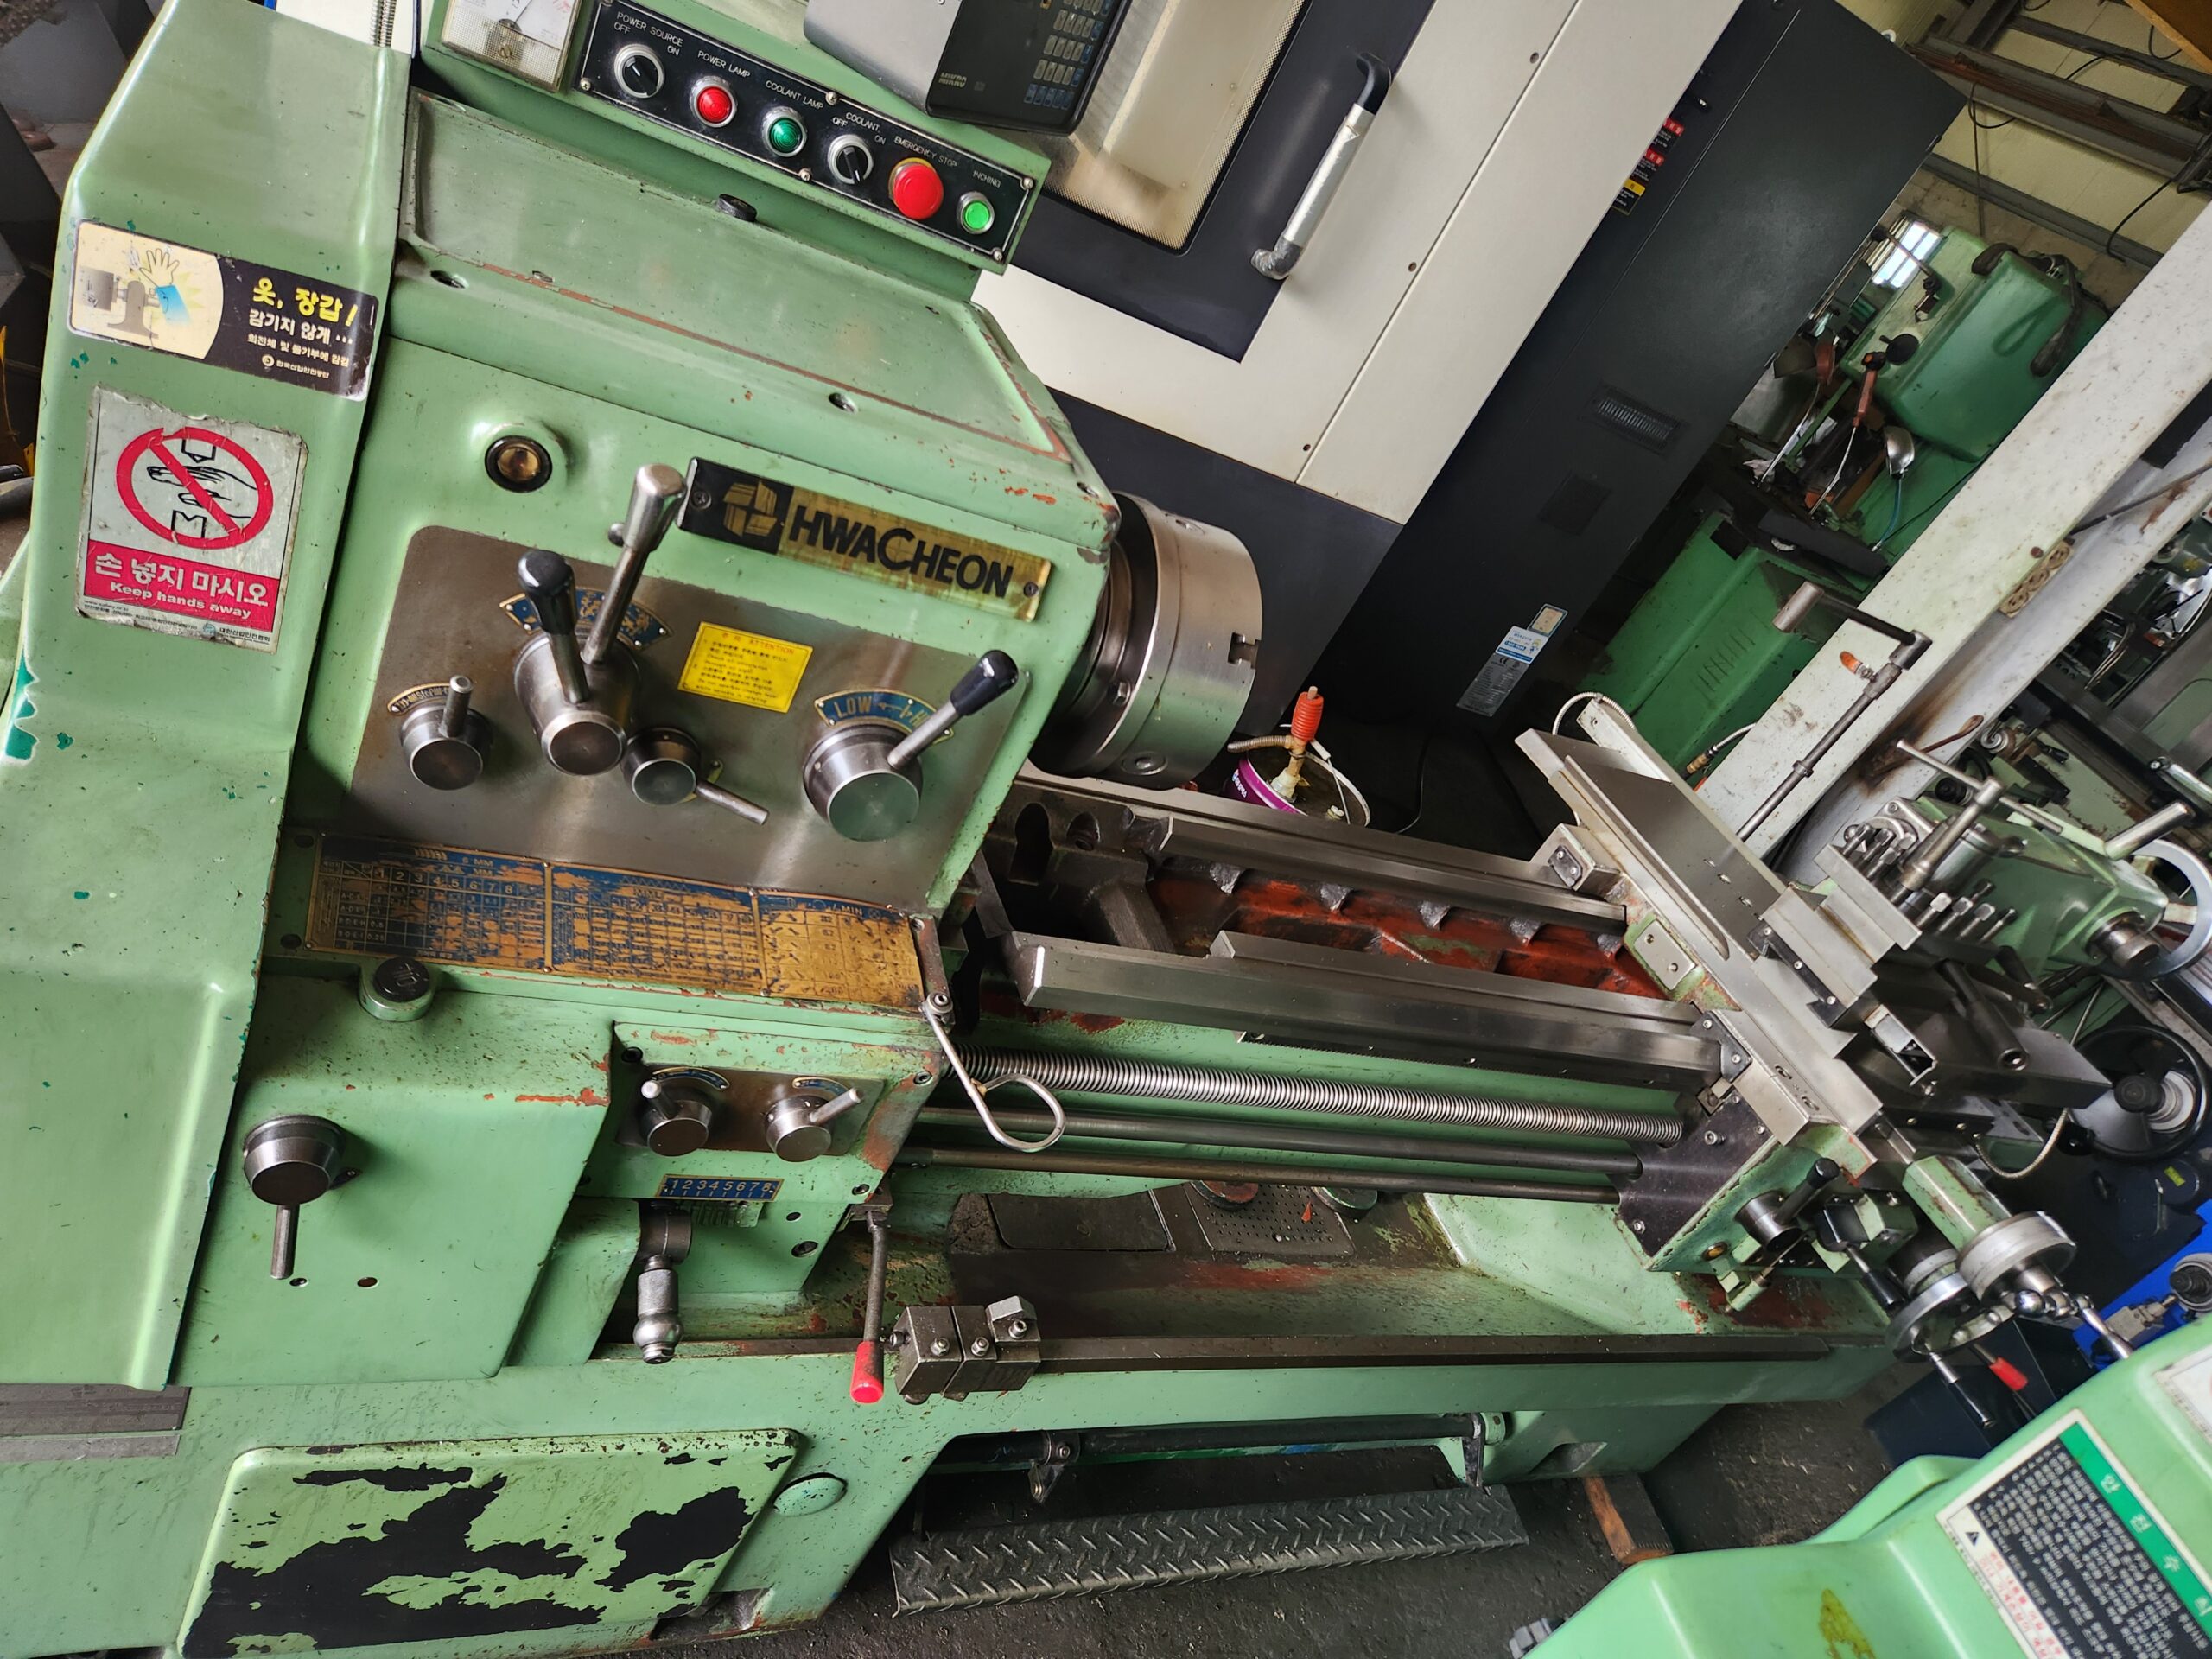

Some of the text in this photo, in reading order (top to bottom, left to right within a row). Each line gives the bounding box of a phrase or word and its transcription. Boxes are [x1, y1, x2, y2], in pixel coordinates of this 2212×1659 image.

[613, 22, 632, 35] OFF
[617, 11, 684, 47] POWER SOURCE
[667, 45, 681, 57] ON
[697, 50, 751, 79] POWER LAMP
[766, 80, 824, 110] COOLANT LAMP
[832, 117, 849, 128] OFF
[845, 111, 880, 131] COOLANT
[874, 135, 887, 145] ON
[893, 135, 957, 167] EMERGENCY STOP
[973, 170, 1002, 188] INCHING
[249, 308, 296, 336] 감기지
[789, 505, 1014, 598] HWACHEON
[95, 552, 269, 607] 손 넣지 마시오
[111, 582, 251, 620] Keep hands away
[834, 696, 873, 718] LOW
[396, 871, 404, 881] 2
[415, 874, 423, 883] 3
[433, 876, 442, 886] 4
[451, 879, 460, 887] 5
[469, 881, 478, 890] 6
[489, 883, 495, 893] 7
[505, 885, 512, 894] 8
[671, 1179, 772, 1192] 1 2 3 4 5 6 7 8
[2101, 1475, 2120, 1494] 안
[2162, 1554, 2181, 1573] 수
